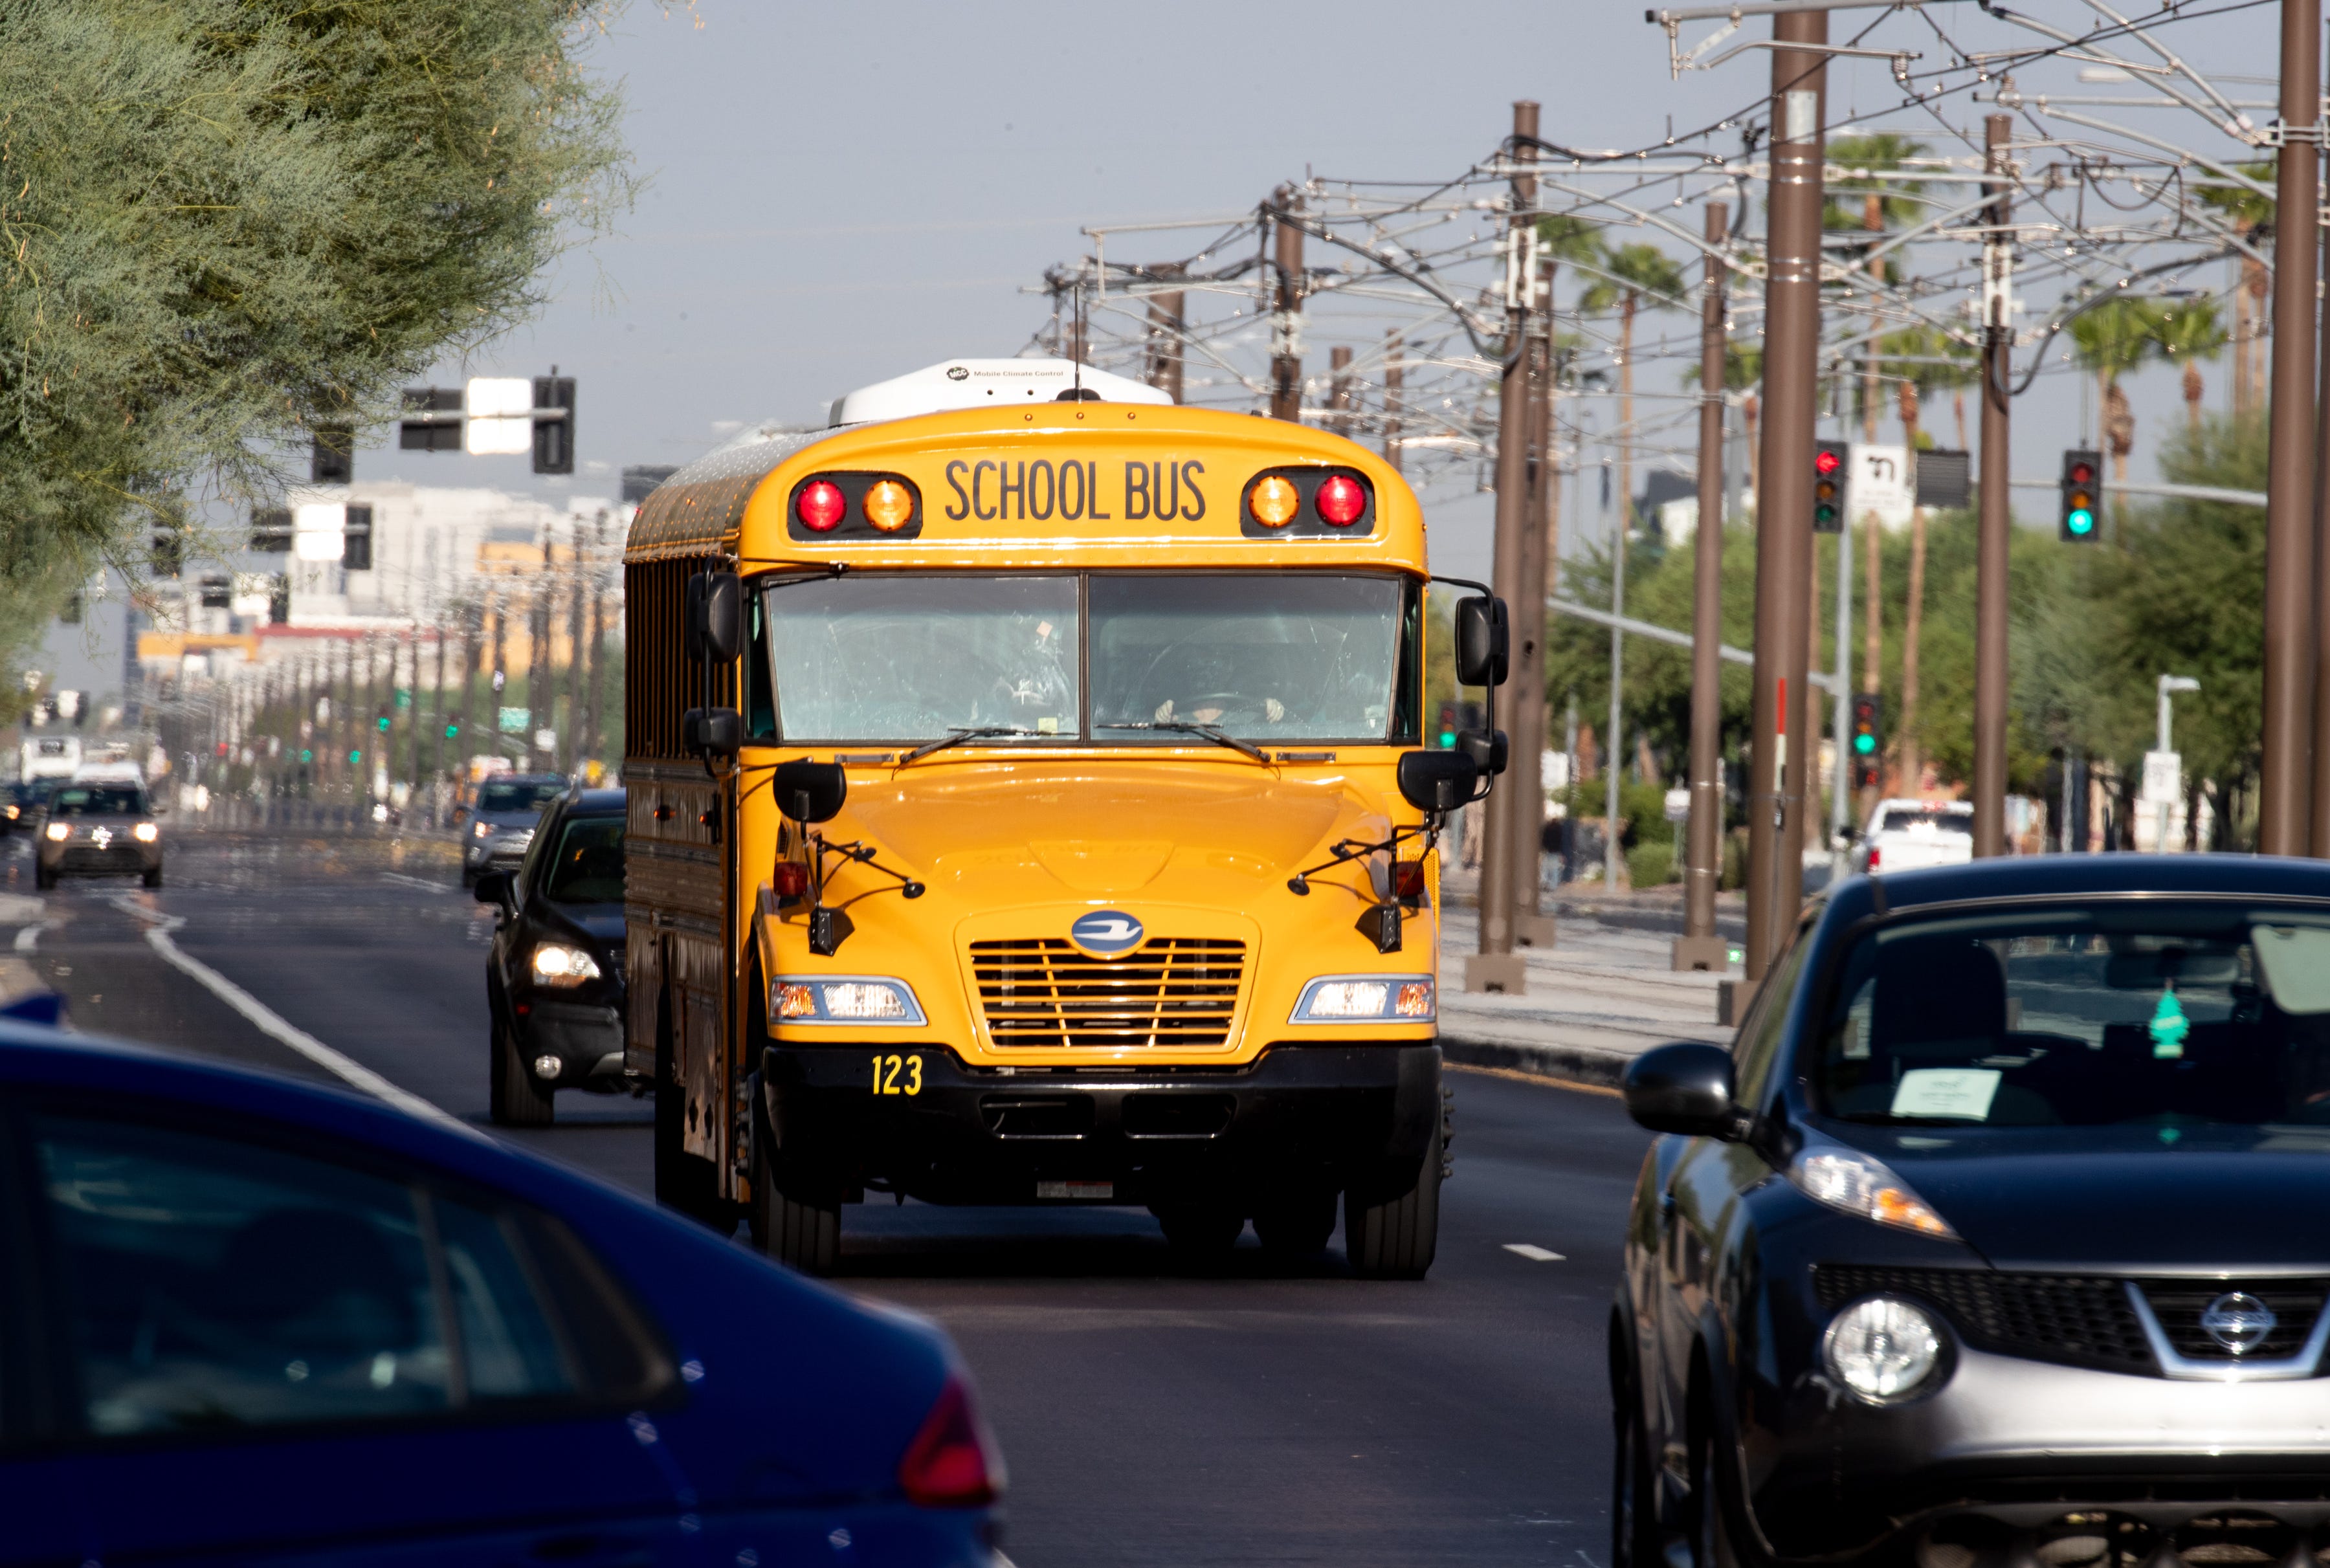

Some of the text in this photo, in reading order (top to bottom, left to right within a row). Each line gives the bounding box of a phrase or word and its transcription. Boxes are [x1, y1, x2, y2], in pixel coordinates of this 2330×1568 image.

[949, 369, 967, 379] MCC
[945, 459, 1206, 522] SCHOOL BUS
[872, 1054, 922, 1096] 123
